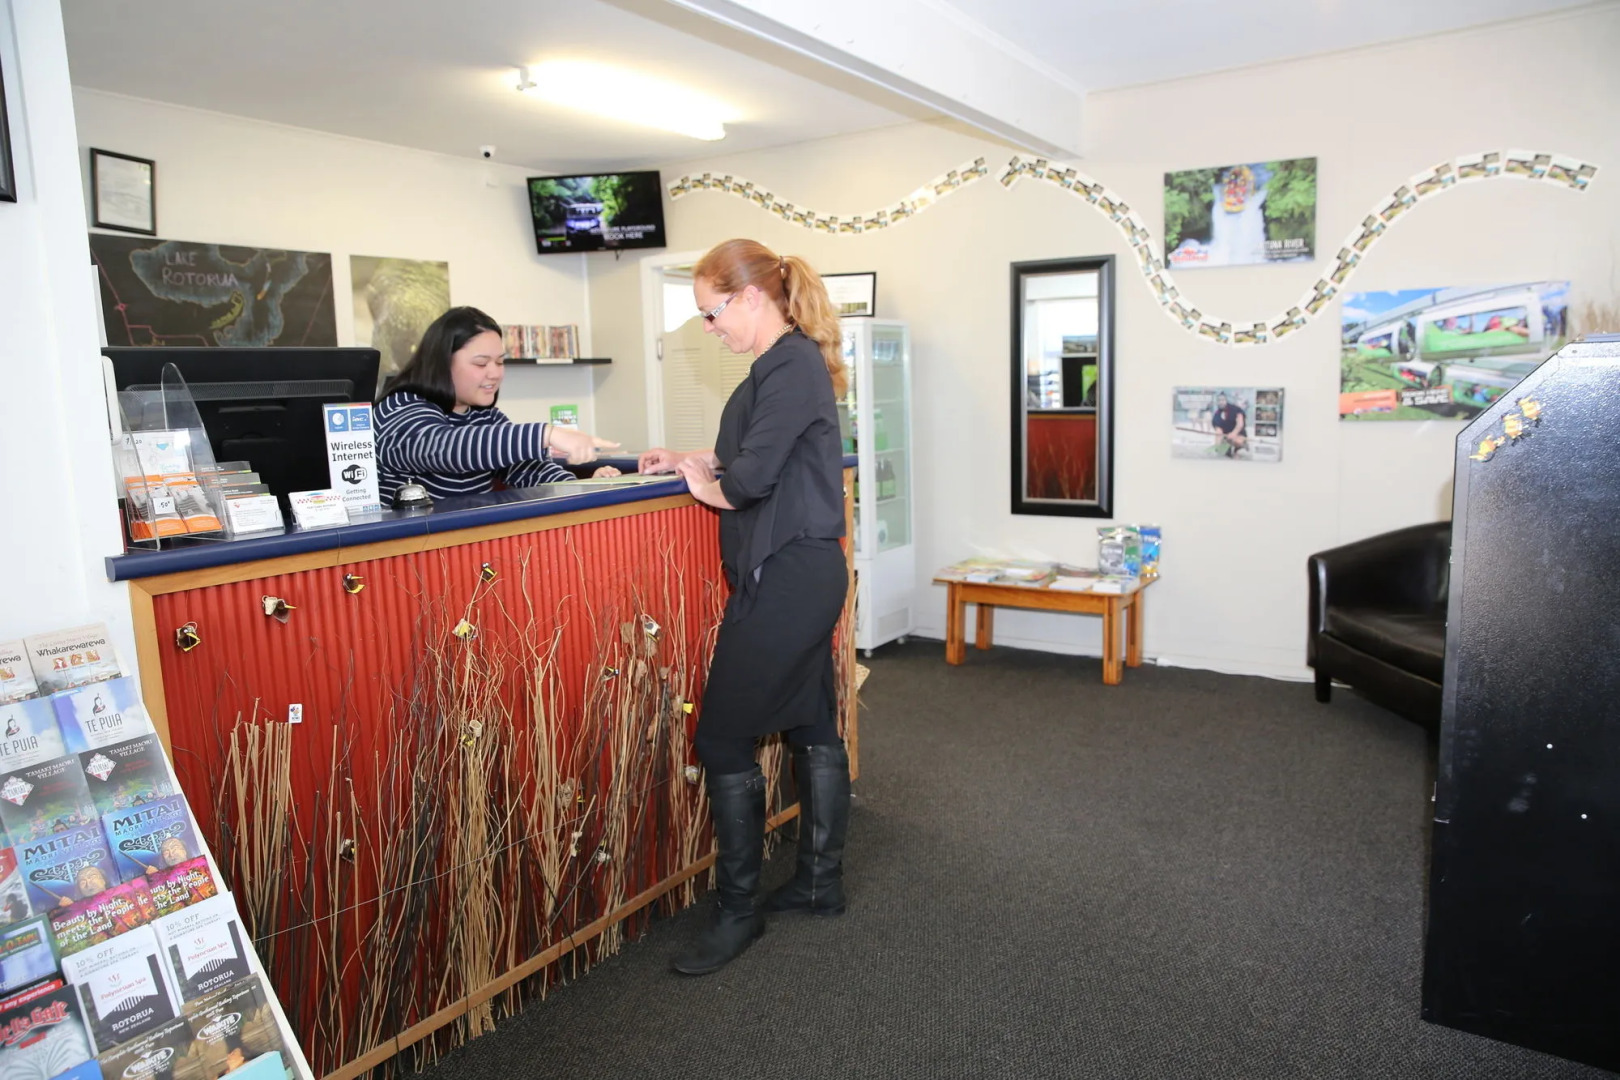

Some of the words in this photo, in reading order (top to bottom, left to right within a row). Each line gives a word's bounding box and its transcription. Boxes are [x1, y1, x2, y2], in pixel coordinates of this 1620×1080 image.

[162, 267, 239, 287] ROTORUA
[331, 441, 372, 451] Wireless
[332, 451, 373, 461] Internet
[36, 639, 106, 657] Whakarewarewa
[85, 719, 98, 733] TE
[99, 713, 123, 731] PUIA
[12, 736, 39, 752] PUIA
[119, 746, 146, 758] VILLAGE
[37, 767, 66, 779] VILLAGE
[113, 800, 181, 831] MITAI
[115, 822, 144, 836] MAORI
[24, 826, 100, 860] MITAI
[26, 851, 58, 866] MAORI
[166, 880, 176, 888] by
[168, 887, 181, 895] the
[182, 877, 209, 890] People
[169, 891, 190, 904] Land
[53, 914, 85, 931] Beauty
[86, 909, 97, 919] by
[57, 924, 86, 940] meets
[88, 916, 104, 926] the
[104, 903, 135, 921] People
[185, 913, 200, 924] OFF
[59, 939, 70, 948] of
[72, 931, 88, 943] the
[90, 921, 113, 936] Land
[97, 947, 114, 959] OFF
[136, 977, 147, 985] Spa
[197, 969, 234, 991] ROTORUA
[18, 984, 56, 1002] experience
[112, 1007, 154, 1031] ROTORUA
